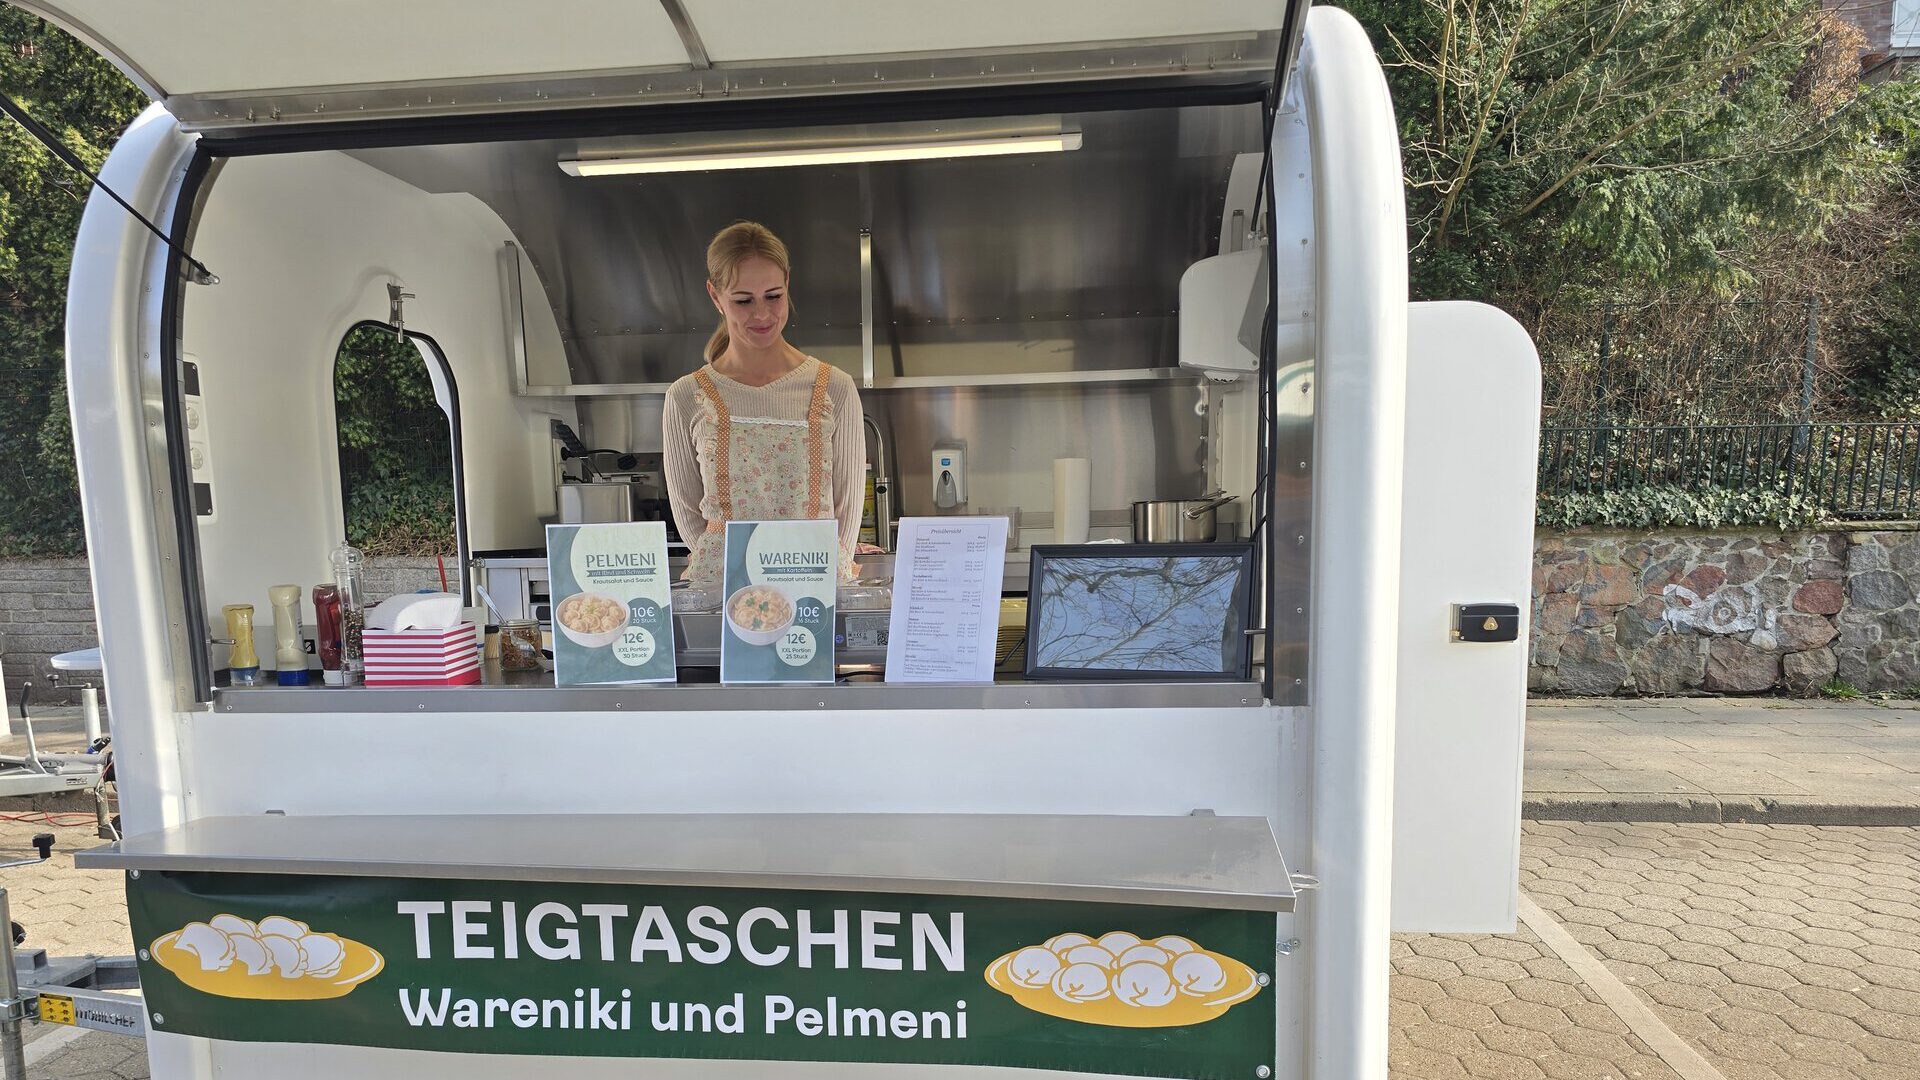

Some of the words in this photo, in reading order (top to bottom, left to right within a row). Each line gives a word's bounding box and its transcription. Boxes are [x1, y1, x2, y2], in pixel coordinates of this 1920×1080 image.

[585, 553, 656, 568] PELMENI
[758, 551, 829, 565] WARENIKI
[631, 606, 656, 618] 10€
[797, 606, 820, 618] 10€
[622, 633, 644, 644] 12€
[785, 633, 807, 645] 12€
[397, 900, 966, 972] TEIGTASCHEN
[398, 987, 632, 1031] Wareniki
[651, 993, 745, 1034] und
[765, 995, 968, 1039] Pelmeni
